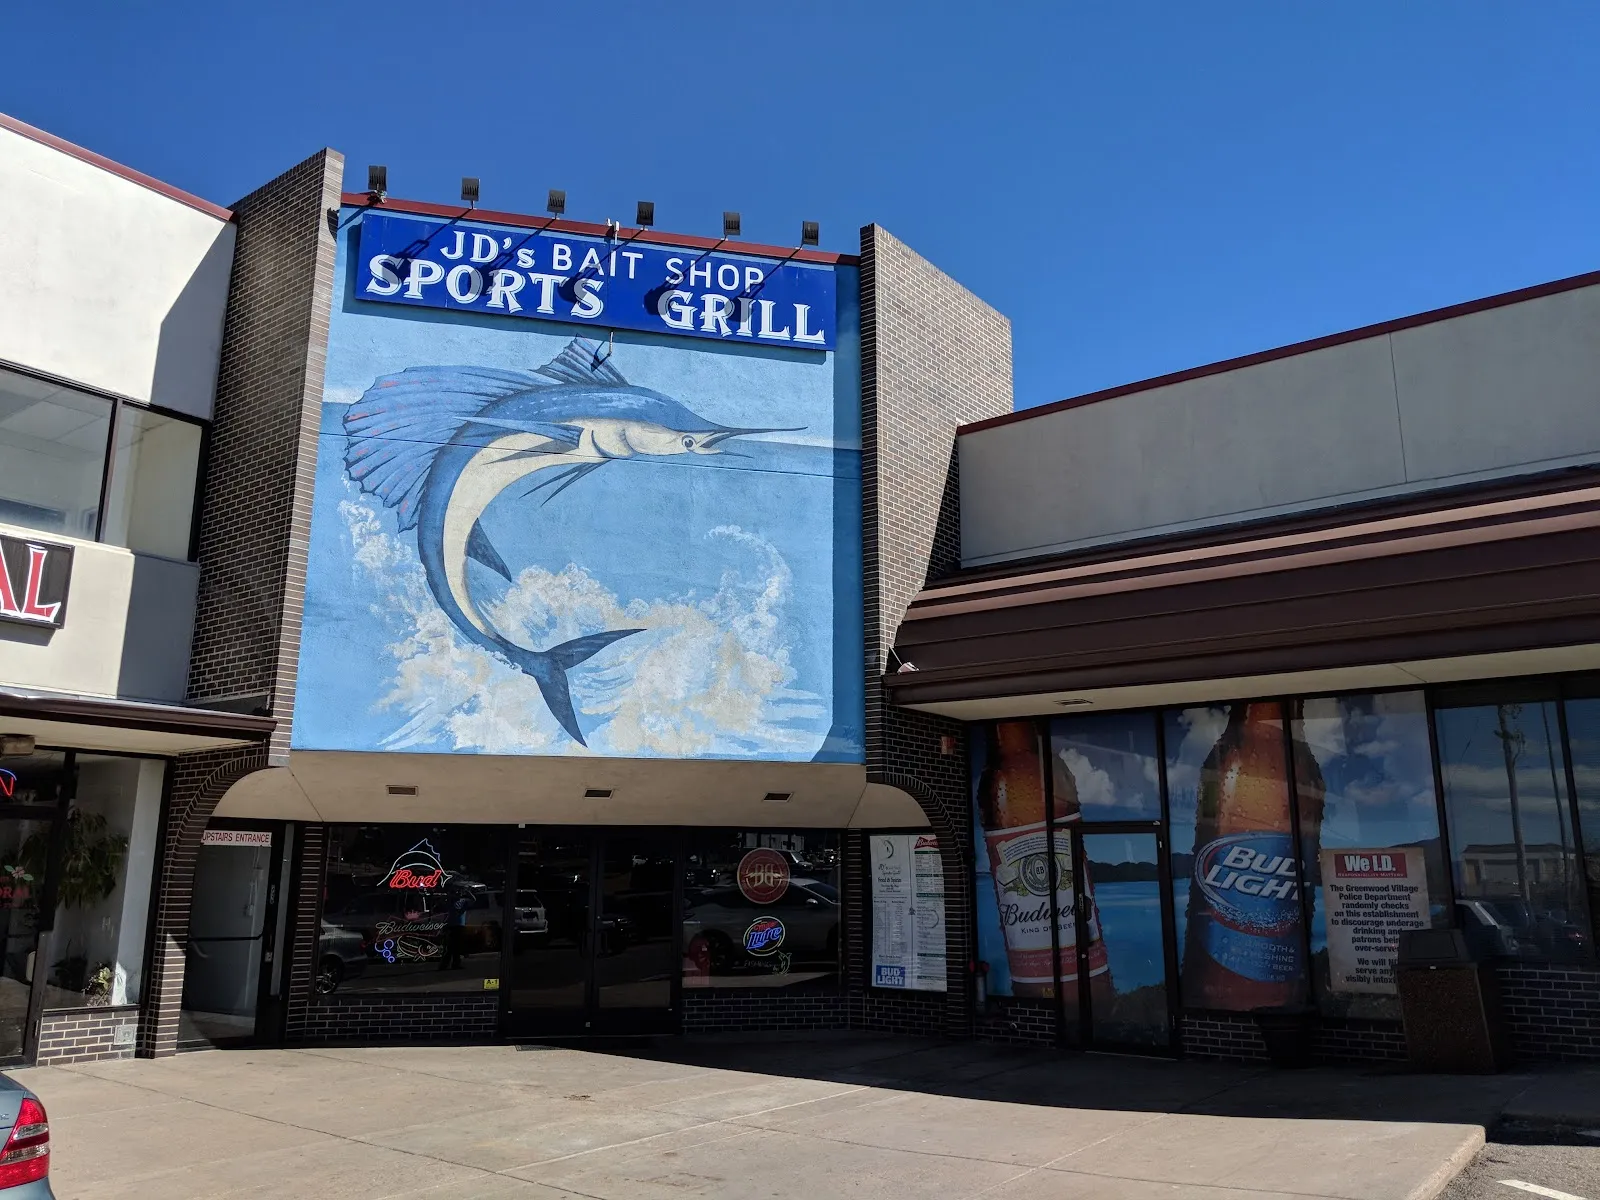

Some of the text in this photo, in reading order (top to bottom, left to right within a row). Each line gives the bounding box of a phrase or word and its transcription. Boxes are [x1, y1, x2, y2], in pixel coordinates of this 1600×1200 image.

[440, 231, 764, 291] JD's BAIT SHOP
[365, 254, 826, 345] SPORTS GRILL
[202, 831, 270, 843] UPSTAIRS ENTRANCE
[1222, 846, 1306, 877] BUD
[1344, 855, 1396, 872] We I.D.
[389, 869, 442, 888] Bud
[1204, 864, 1311, 900] LIGHT
[1391, 885, 1419, 893] Village
[1339, 893, 1411, 902] Police Department
[1341, 902, 1409, 911] randomly checks
[1346, 910, 1361, 918] this
[1362, 910, 1419, 918] establishment
[1341, 919, 1384, 928] discourage
[1386, 919, 1424, 928] underage
[1352, 927, 1386, 937] drinking
[745, 926, 783, 950] Lite
[1351, 935, 1400, 944] patrons bein
[1357, 957, 1370, 966] We
[1371, 958, 1386, 966] will
[881, 967, 900, 976] BUD
[1355, 967, 1377, 975] serve
[877, 975, 903, 985] LIGHT
[1345, 975, 1397, 985] visibly intoxi
